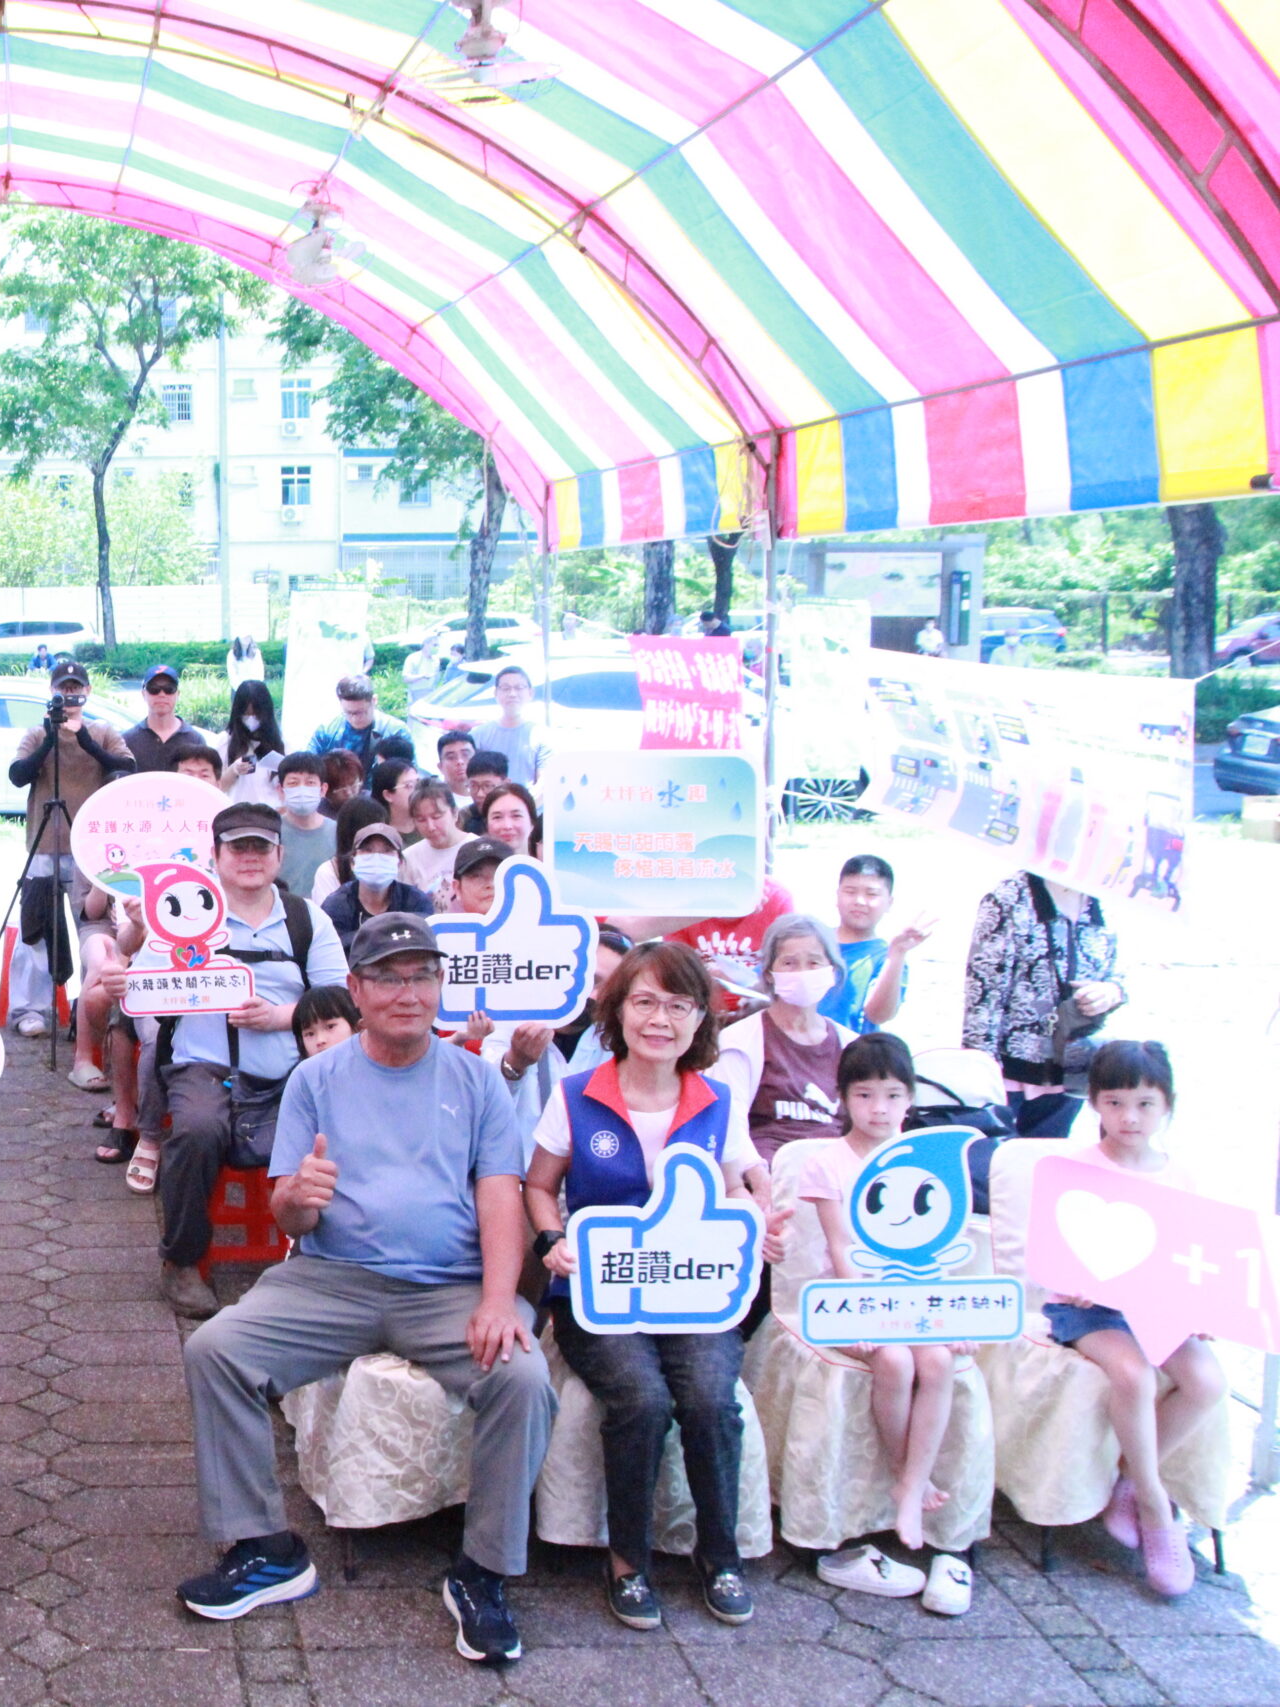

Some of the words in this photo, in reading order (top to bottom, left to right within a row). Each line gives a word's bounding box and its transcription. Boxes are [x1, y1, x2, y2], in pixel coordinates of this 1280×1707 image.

[87, 820, 153, 834] 愛護水源
[574, 832, 696, 853] 天賜甘甜雨露
[613, 858, 736, 879] 疼惜涓涓流水
[448, 953, 571, 985] 超讚der
[600, 1250, 735, 1285] 超讚der
